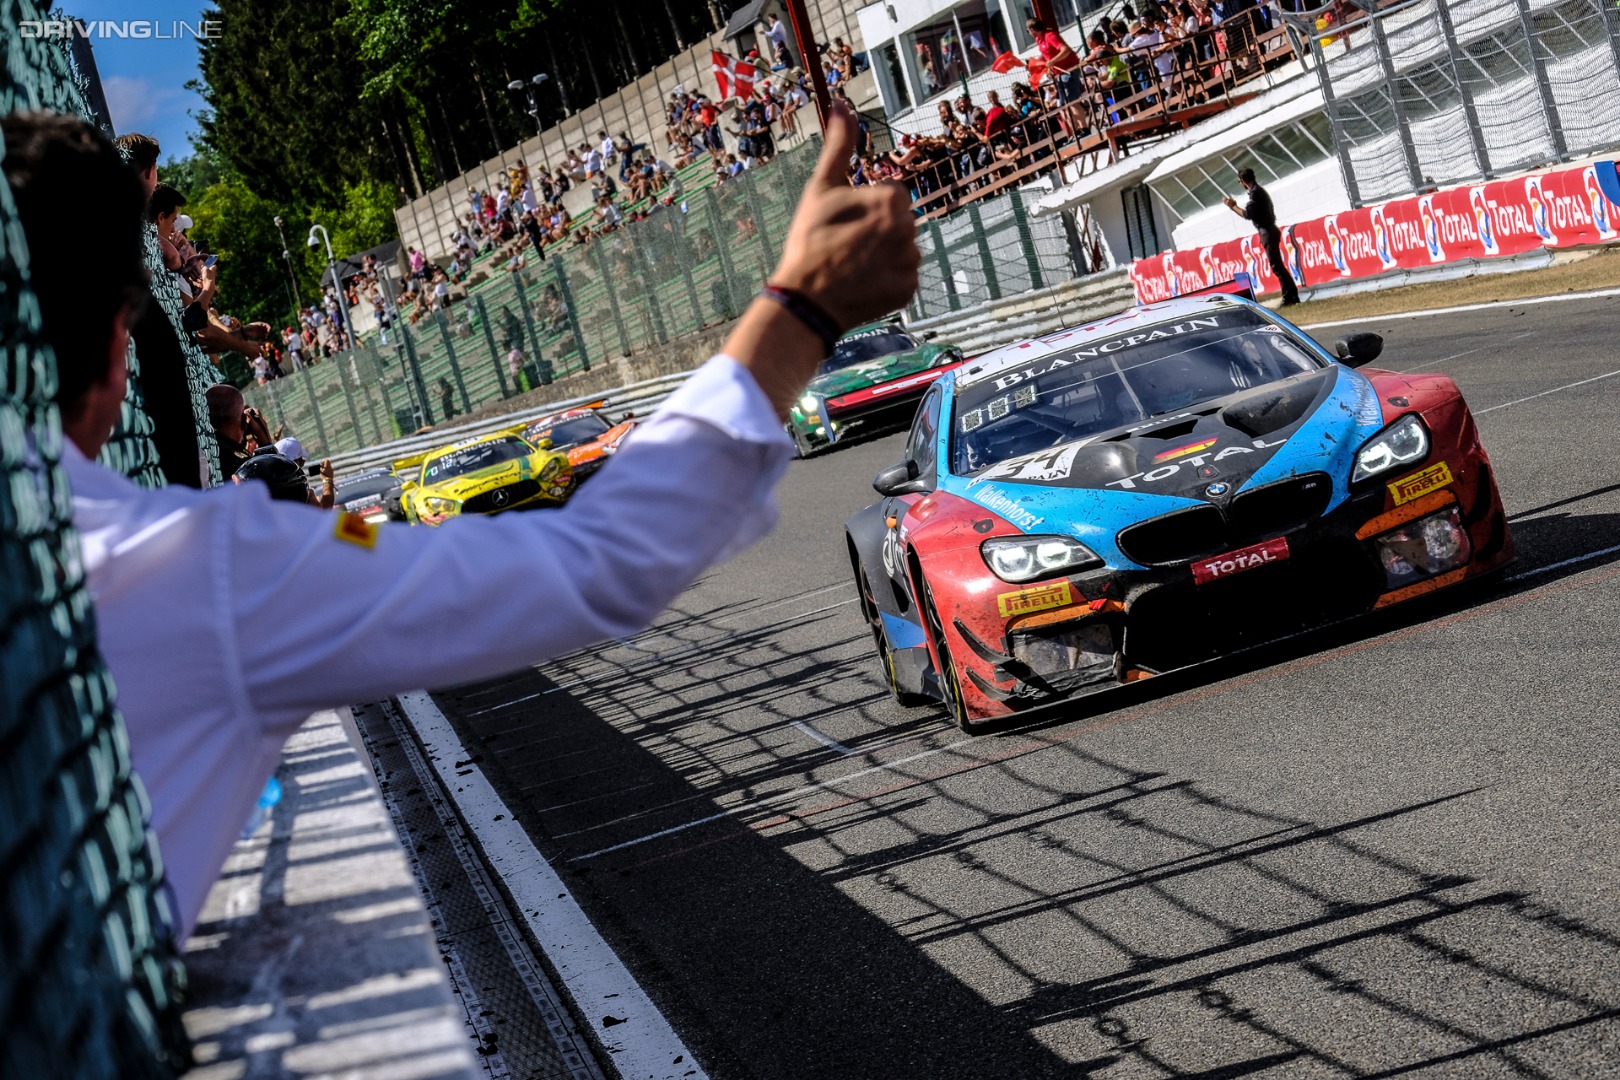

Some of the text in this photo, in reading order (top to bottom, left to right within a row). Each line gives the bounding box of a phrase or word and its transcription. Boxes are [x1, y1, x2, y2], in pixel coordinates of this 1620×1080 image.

[1296, 236, 1333, 269] TOTAL
[1340, 227, 1377, 260] TOTAL
[1386, 217, 1426, 252] TOTAL
[1434, 208, 1478, 243] TOTAL
[1487, 200, 1534, 237] TOTAL
[1543, 191, 1592, 229] TOTAL
[1136, 273, 1170, 303] TOTAL
[835, 327, 890, 348] NCPAIN
[991, 315, 1220, 393] BLANCPAIN
[1105, 438, 1289, 489] TOTAL
[1396, 466, 1448, 499] PIRELLI
[973, 483, 1045, 531] Walkenhorst
[1204, 548, 1278, 577] TOTAL
[1006, 585, 1065, 613] PIRELLI
